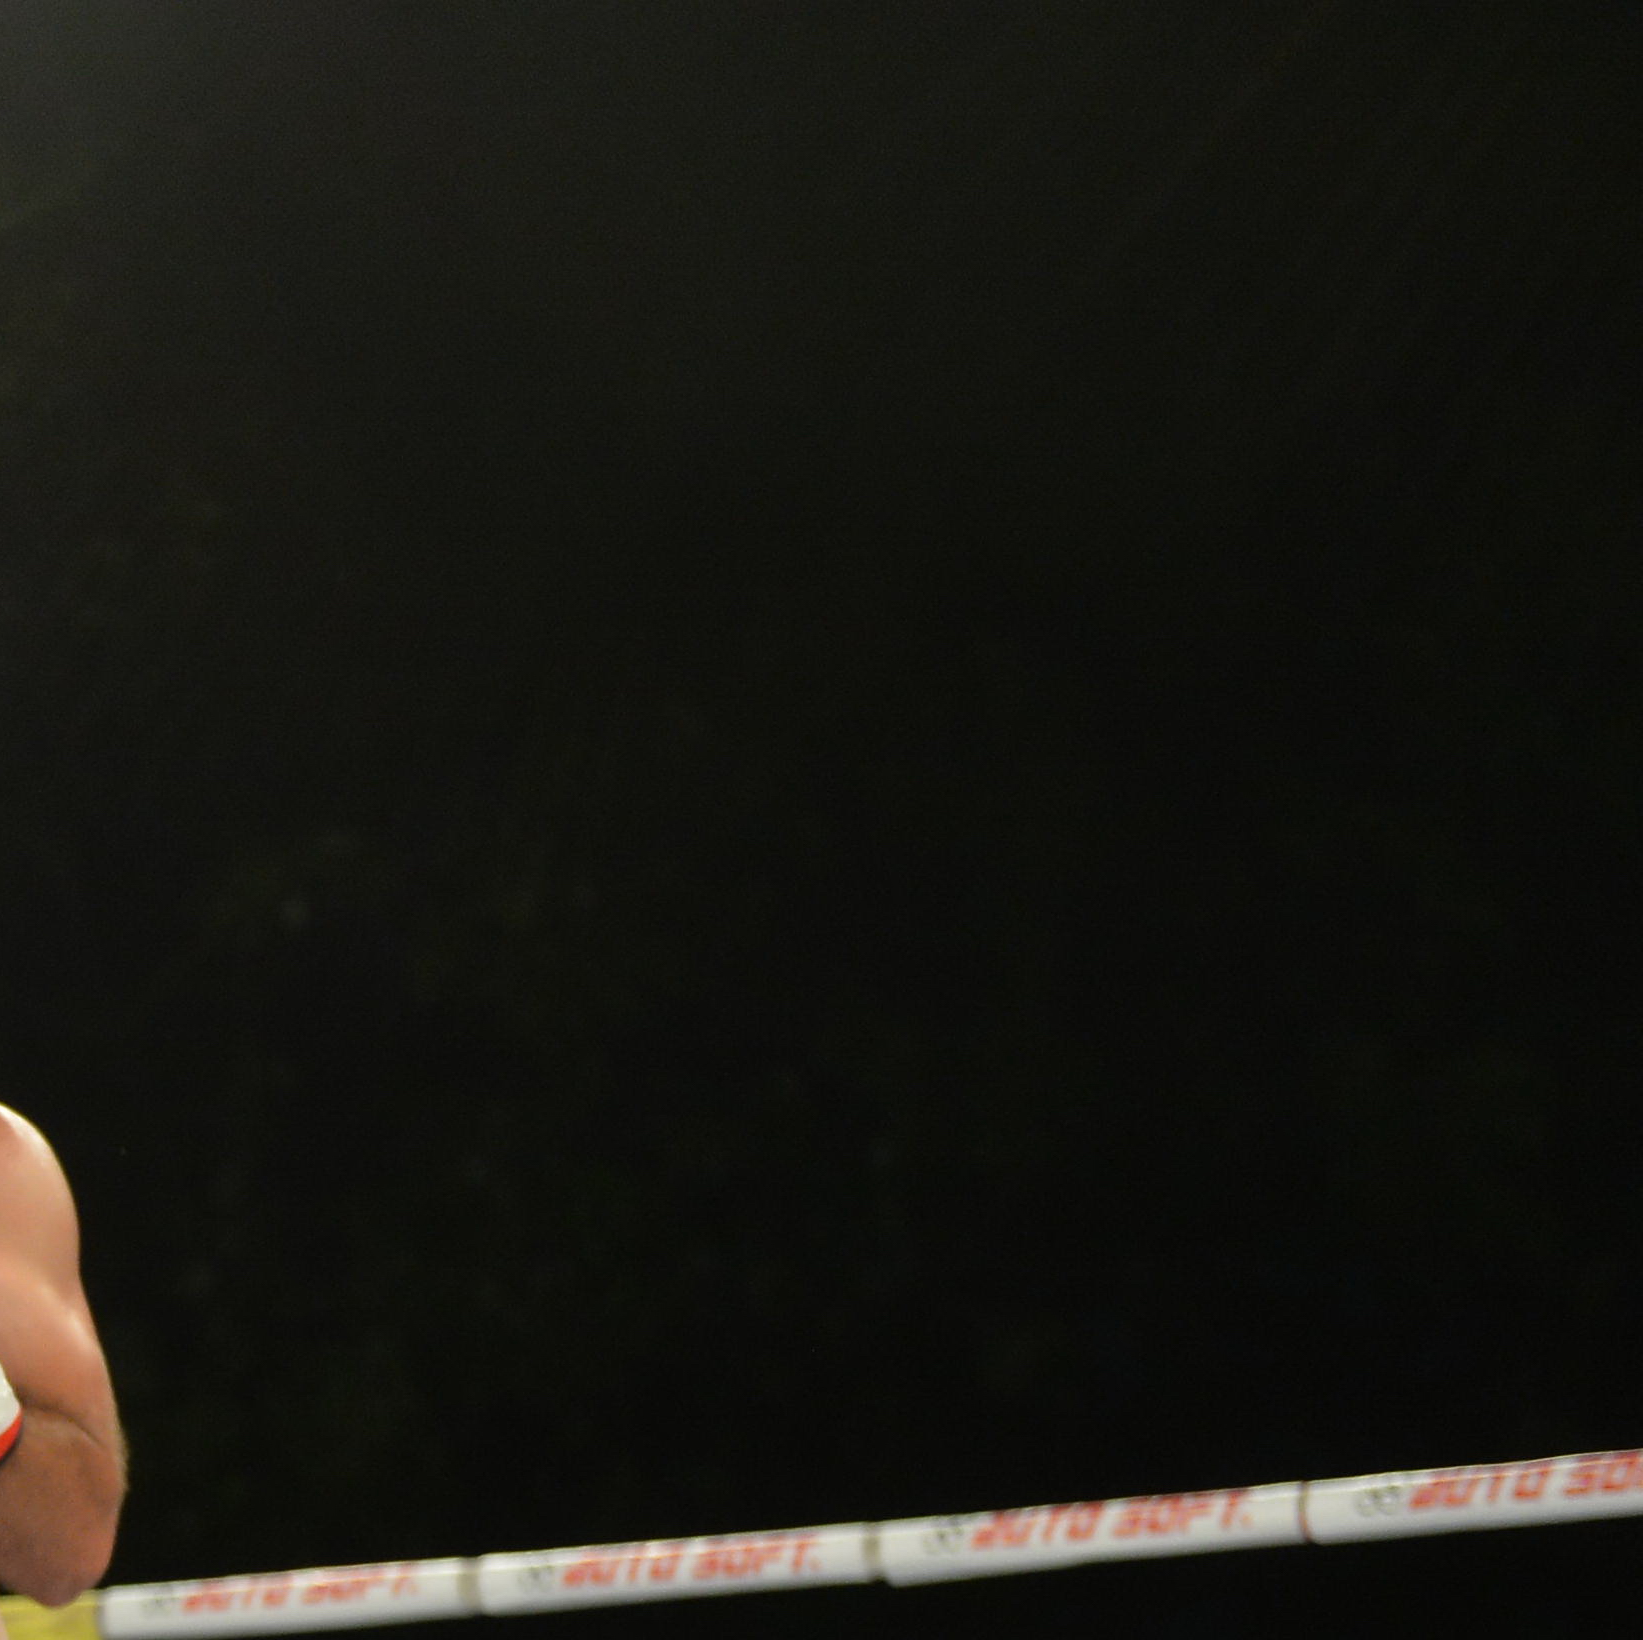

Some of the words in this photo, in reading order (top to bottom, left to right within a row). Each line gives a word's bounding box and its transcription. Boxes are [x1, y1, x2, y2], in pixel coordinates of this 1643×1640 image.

[1408, 1459, 1555, 1510] AUTO
[970, 1500, 1107, 1550] AUTO
[560, 1543, 685, 1588] AUTO
[180, 1569, 295, 1614] AUTO
